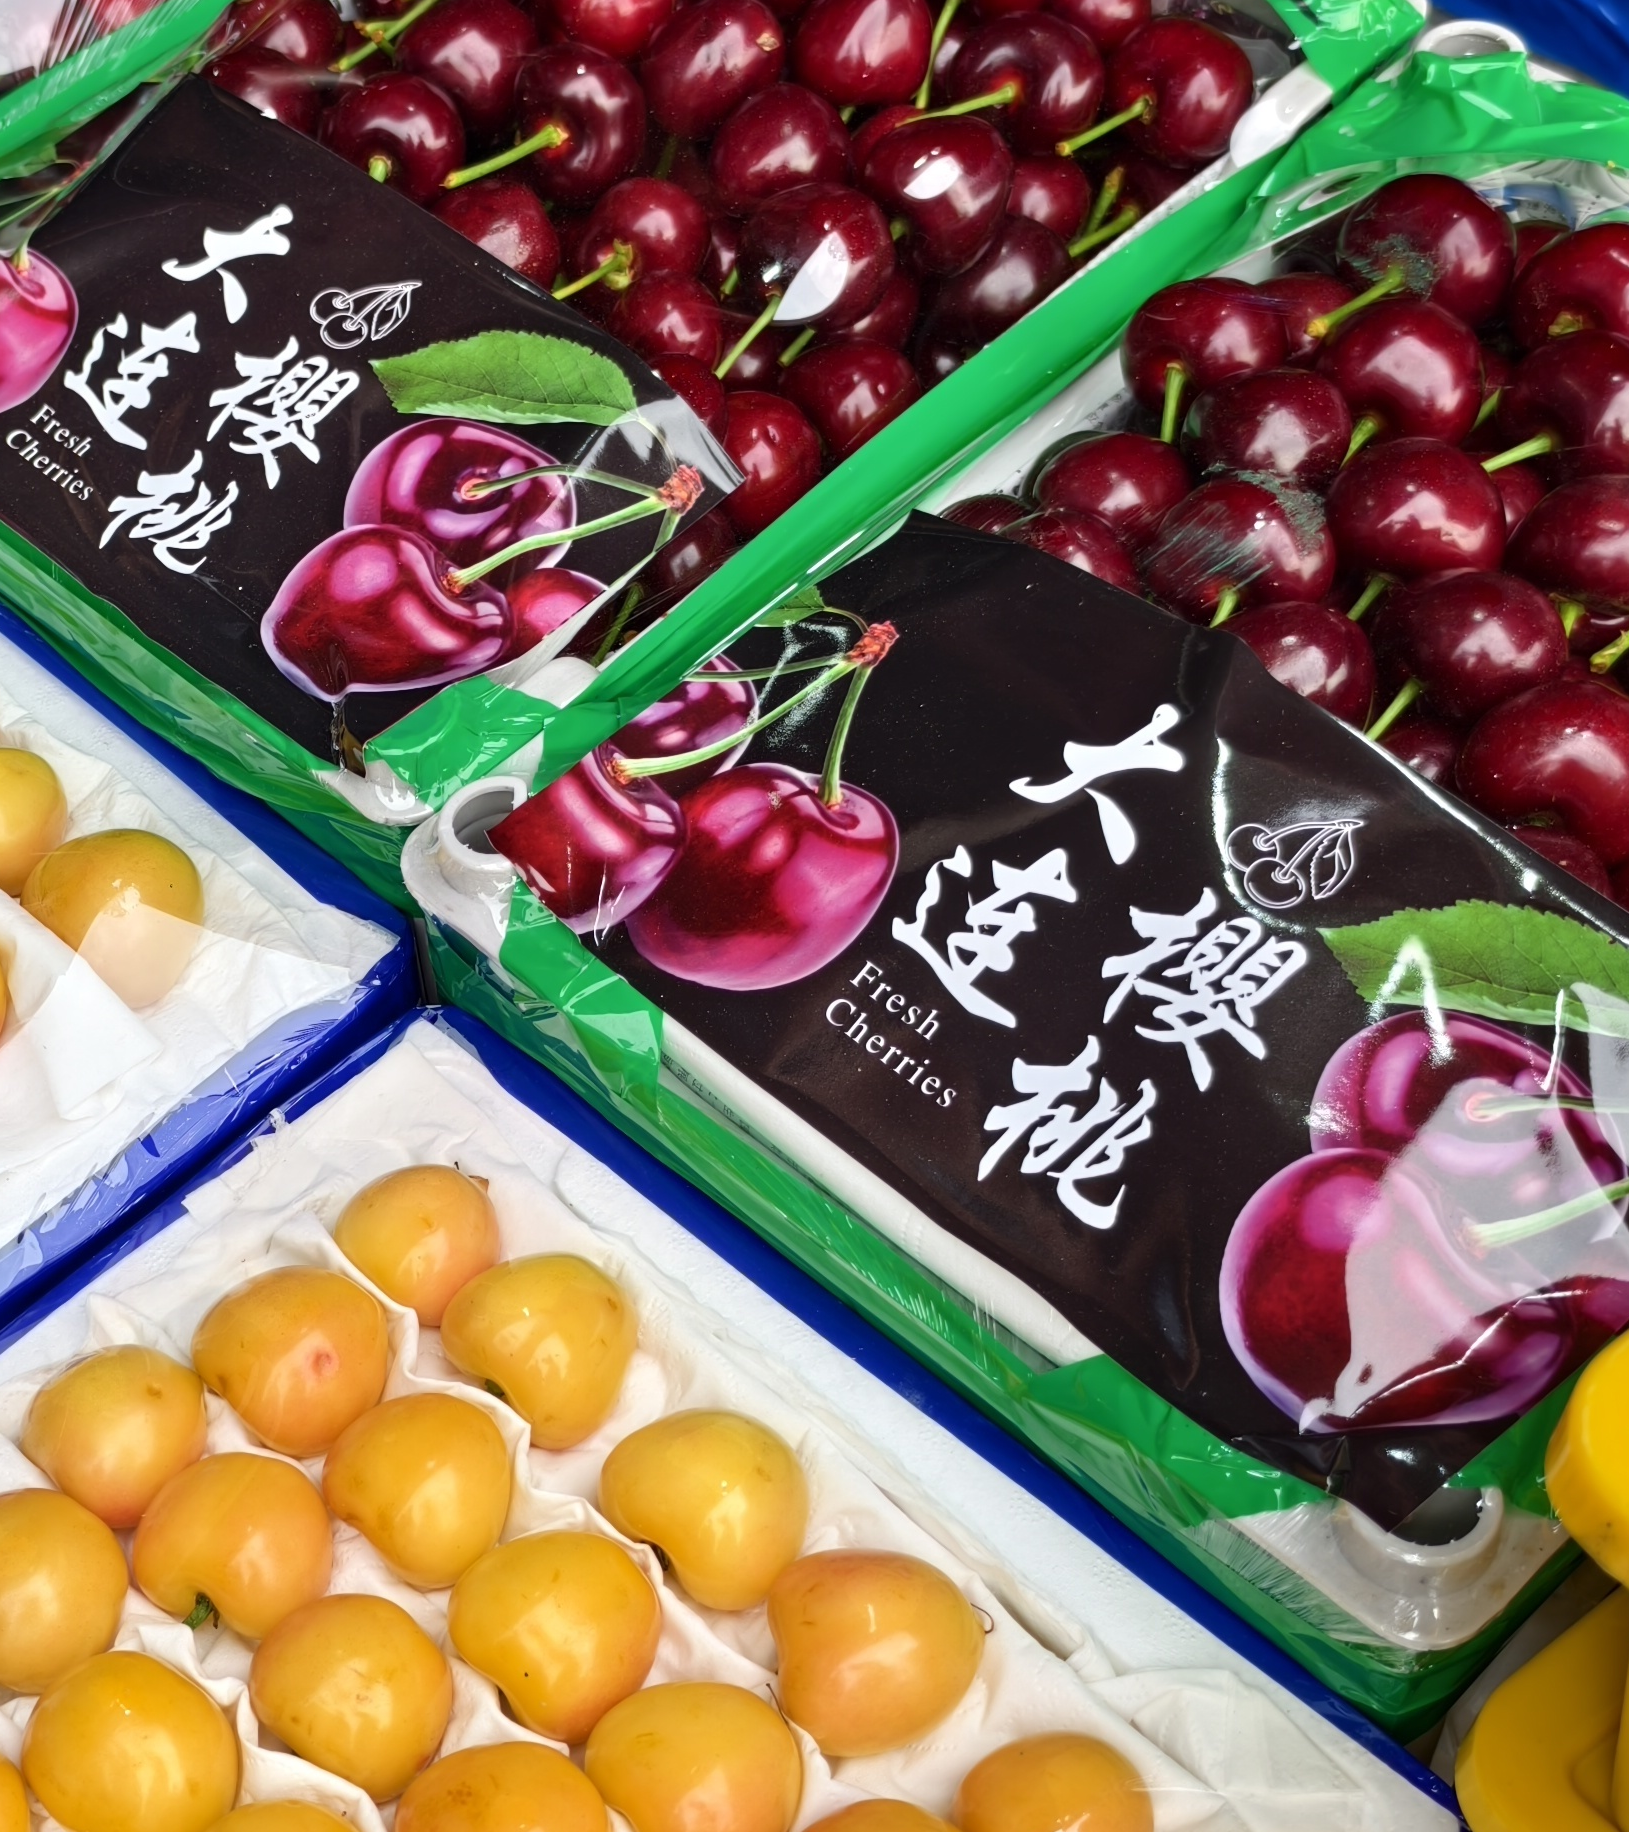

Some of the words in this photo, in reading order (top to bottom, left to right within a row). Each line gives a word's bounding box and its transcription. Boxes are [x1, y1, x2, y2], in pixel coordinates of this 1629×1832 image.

[63, 204, 294, 451] 大连
[6, 429, 93, 501] Cherries
[30, 403, 92, 457] Fresh
[891, 703, 1185, 1029] 大连
[849, 960, 940, 1041] Fresh
[825, 998, 957, 1108] Cherries
